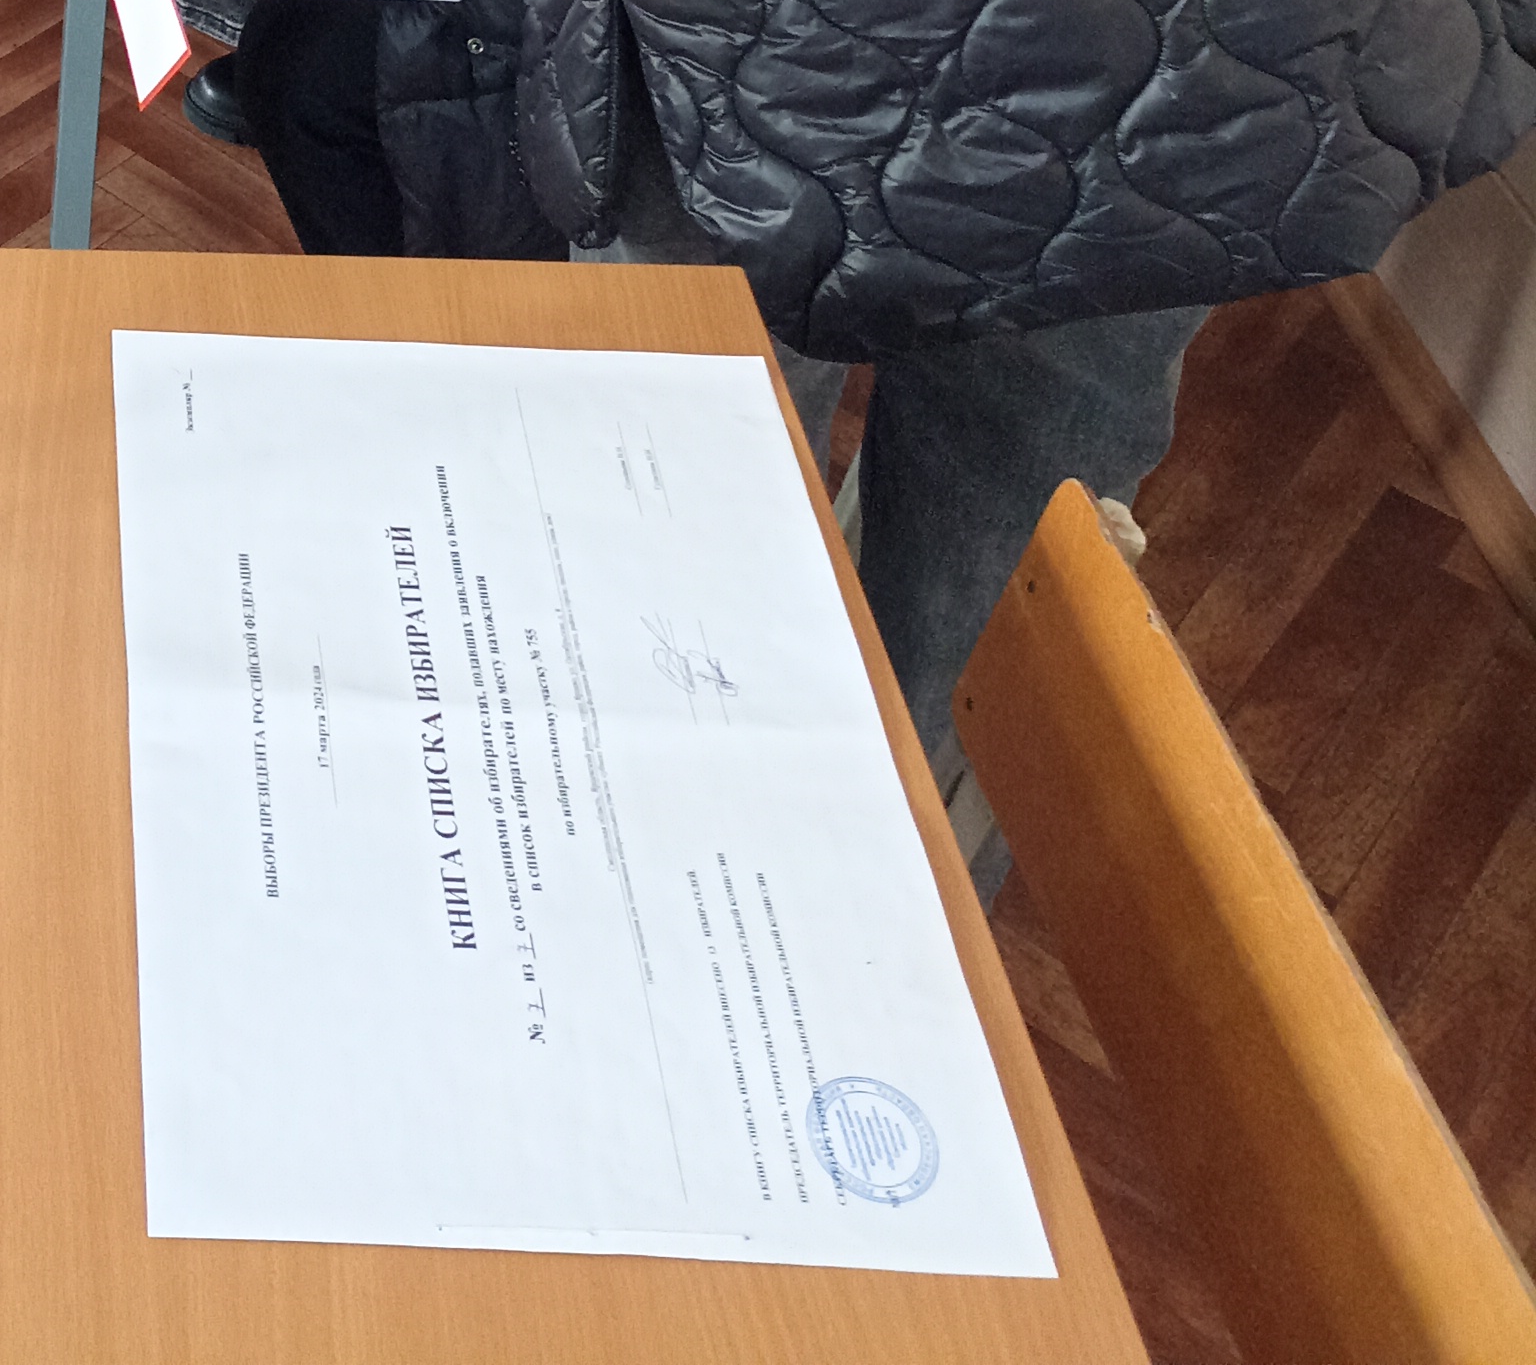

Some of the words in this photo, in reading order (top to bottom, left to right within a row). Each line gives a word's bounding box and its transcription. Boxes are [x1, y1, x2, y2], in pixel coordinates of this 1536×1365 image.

[435, 465, 456, 536] включении
[238, 552, 257, 628] ФЕДЕРАЦИИ
[447, 550, 473, 616] заявления
[386, 525, 440, 702] ИЗБИРАТЕЛЕЙ
[474, 575, 504, 655] нахождения
[525, 628, 538, 647] 755
[244, 632, 265, 724] РОССИЙСКОЙ
[312, 664, 323, 684] года
[462, 621, 486, 687] подавших
[490, 658, 511, 693] месту
[528, 649, 541, 660] №
[313, 686, 325, 710] 2024
[500, 697, 515, 714] по
[534, 663, 557, 707] участку
[316, 714, 331, 752] марта
[254, 729, 273, 827] ПРЕЗИДЕНТА
[317, 755, 329, 768] 17
[421, 712, 459, 839] СПИСКА
[501, 720, 531, 819] избирателей
[545, 711, 573, 817] избирательному
[488, 796, 505, 813] об
[563, 821, 577, 836] по
[261, 832, 280, 898] ВЫБОРЫ
[496, 818, 523, 910] сведениями
[517, 824, 540, 878] список
[439, 849, 478, 950] КНИГА
[530, 883, 542, 891] в
[717, 852, 738, 906] КОМИССИИ
[757, 873, 778, 927] КОМИССИИ
[512, 915, 525, 932] со
[730, 908, 761, 993] ИЗБИРАТЕЛЬНОЙ
[520, 964, 537, 981] из
[712, 962, 731, 1011] ВНЕСЕНО
[770, 929, 803, 1017] ИЗБИРАТЕЛЬНОЙ
[528, 1023, 546, 1044] №
[722, 1014, 748, 1095] ИЗБИРАТЕЛЕЙ
[753, 995, 785, 1107] ТЕРРИТОРИАЛЬНОЙ
[742, 1098, 760, 1146] СПИСКА
[752, 1150, 770, 1190] КНИГУ
[781, 1110, 809, 1203] ПРЕДСЕДАТЕЛЬ
[763, 1193, 772, 1201] В
